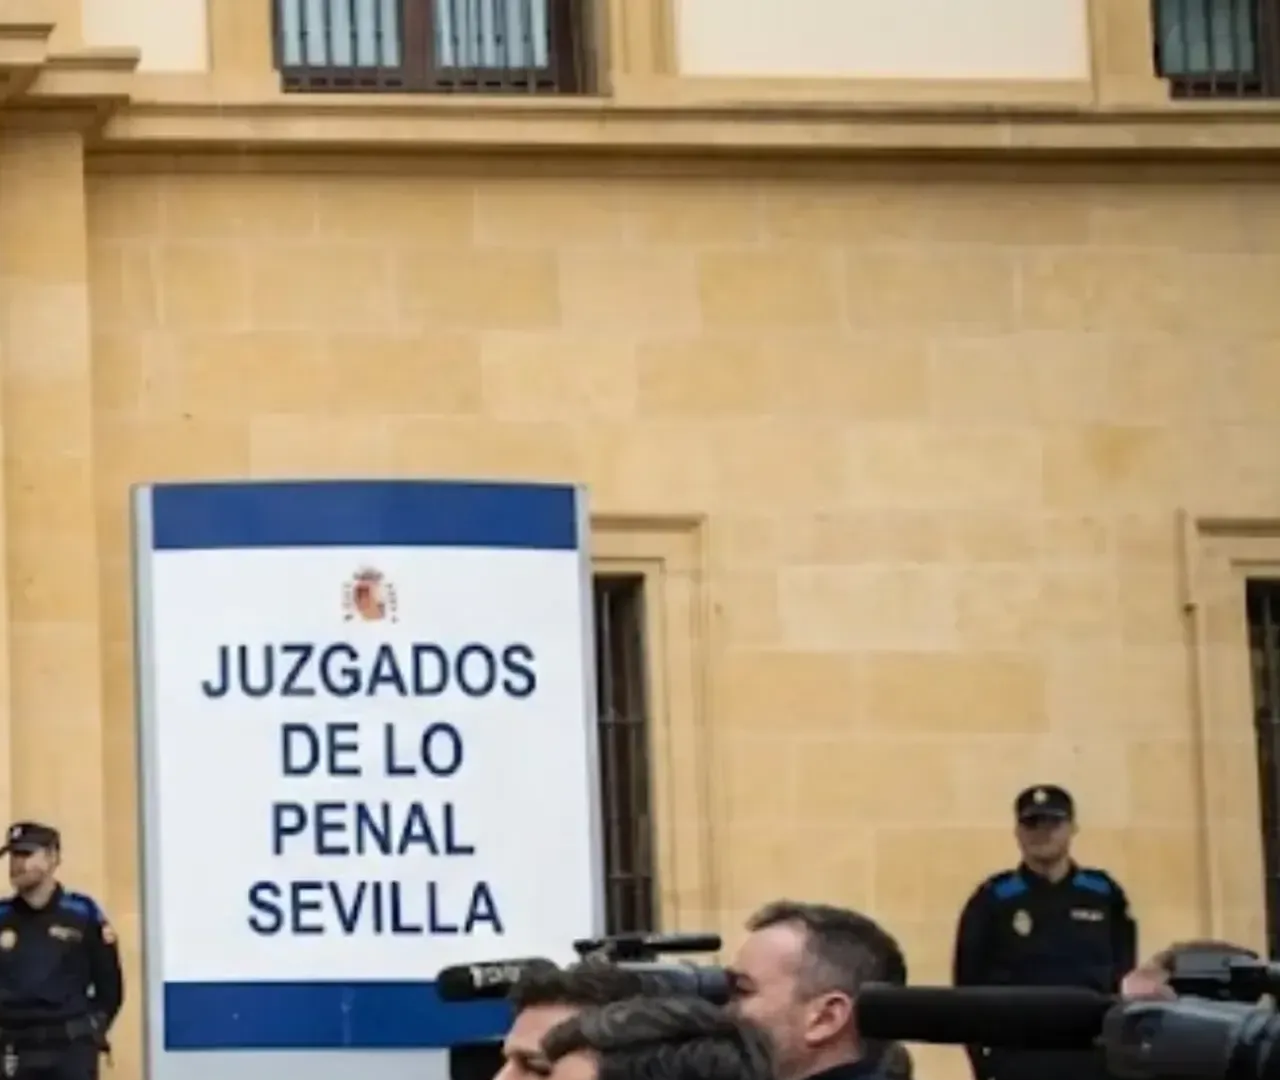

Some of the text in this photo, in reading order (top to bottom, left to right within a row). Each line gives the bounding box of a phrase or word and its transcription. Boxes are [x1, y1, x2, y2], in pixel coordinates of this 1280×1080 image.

[201, 643, 537, 698] JUZGADOS
[281, 722, 463, 777] DE LO
[272, 802, 475, 856] PENAL
[247, 880, 503, 935] SEVILLA
